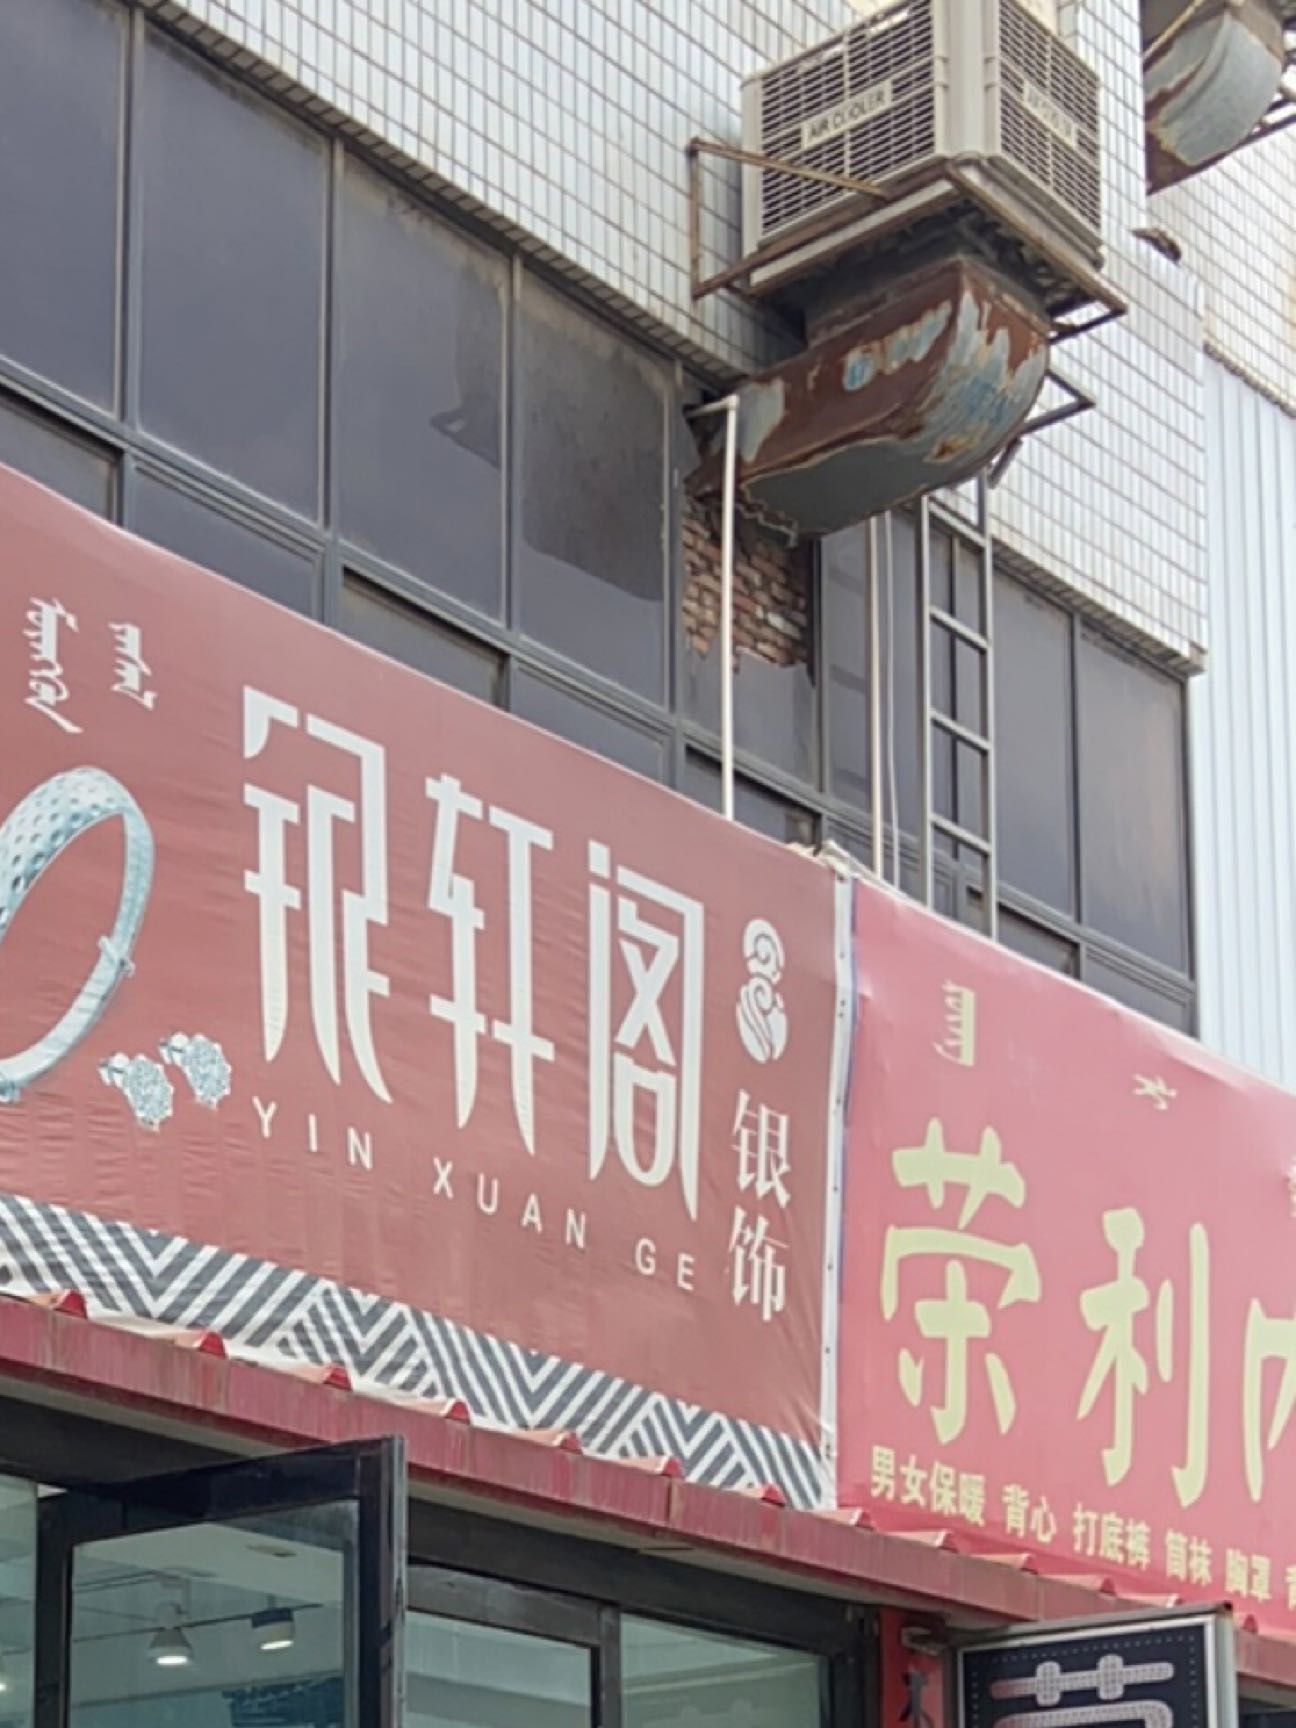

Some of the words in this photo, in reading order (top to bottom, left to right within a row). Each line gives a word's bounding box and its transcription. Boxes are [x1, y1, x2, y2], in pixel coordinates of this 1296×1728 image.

[243, 685, 705, 1222] 银轩阁
[253, 1096, 374, 1171] YIN
[432, 1157, 587, 1249] XUAN
[634, 1238, 695, 1292] GE
[728, 1088, 792, 1322] 银饰
[870, 1444, 987, 1527] 男女保暖
[1002, 1483, 1058, 1544] 背心
